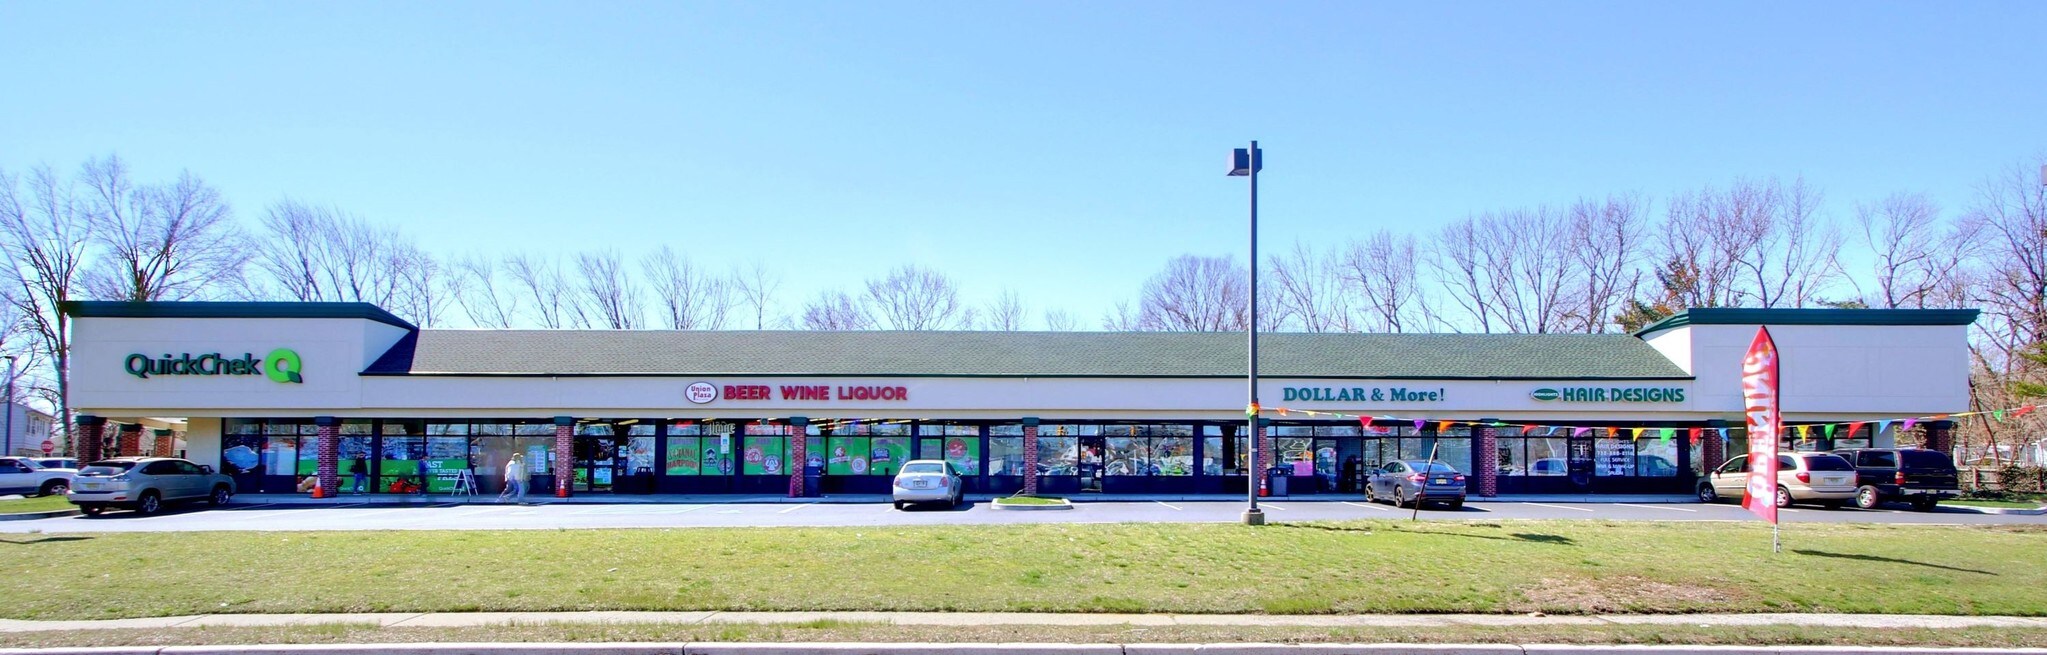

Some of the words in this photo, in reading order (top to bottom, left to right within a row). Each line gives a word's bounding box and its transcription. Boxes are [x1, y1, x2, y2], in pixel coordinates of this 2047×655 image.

[125, 353, 262, 379] QuickChek
[693, 390, 712, 401] Plaza
[723, 385, 771, 400] BEER
[780, 385, 829, 400] WINE
[838, 386, 908, 400] LIQUOR
[1283, 387, 1367, 401] DOLLAR
[1370, 387, 1385, 401] &
[1389, 387, 1445, 401] More!
[1563, 387, 1606, 402] HAIR
[1610, 387, 1685, 402] DESIGNS
